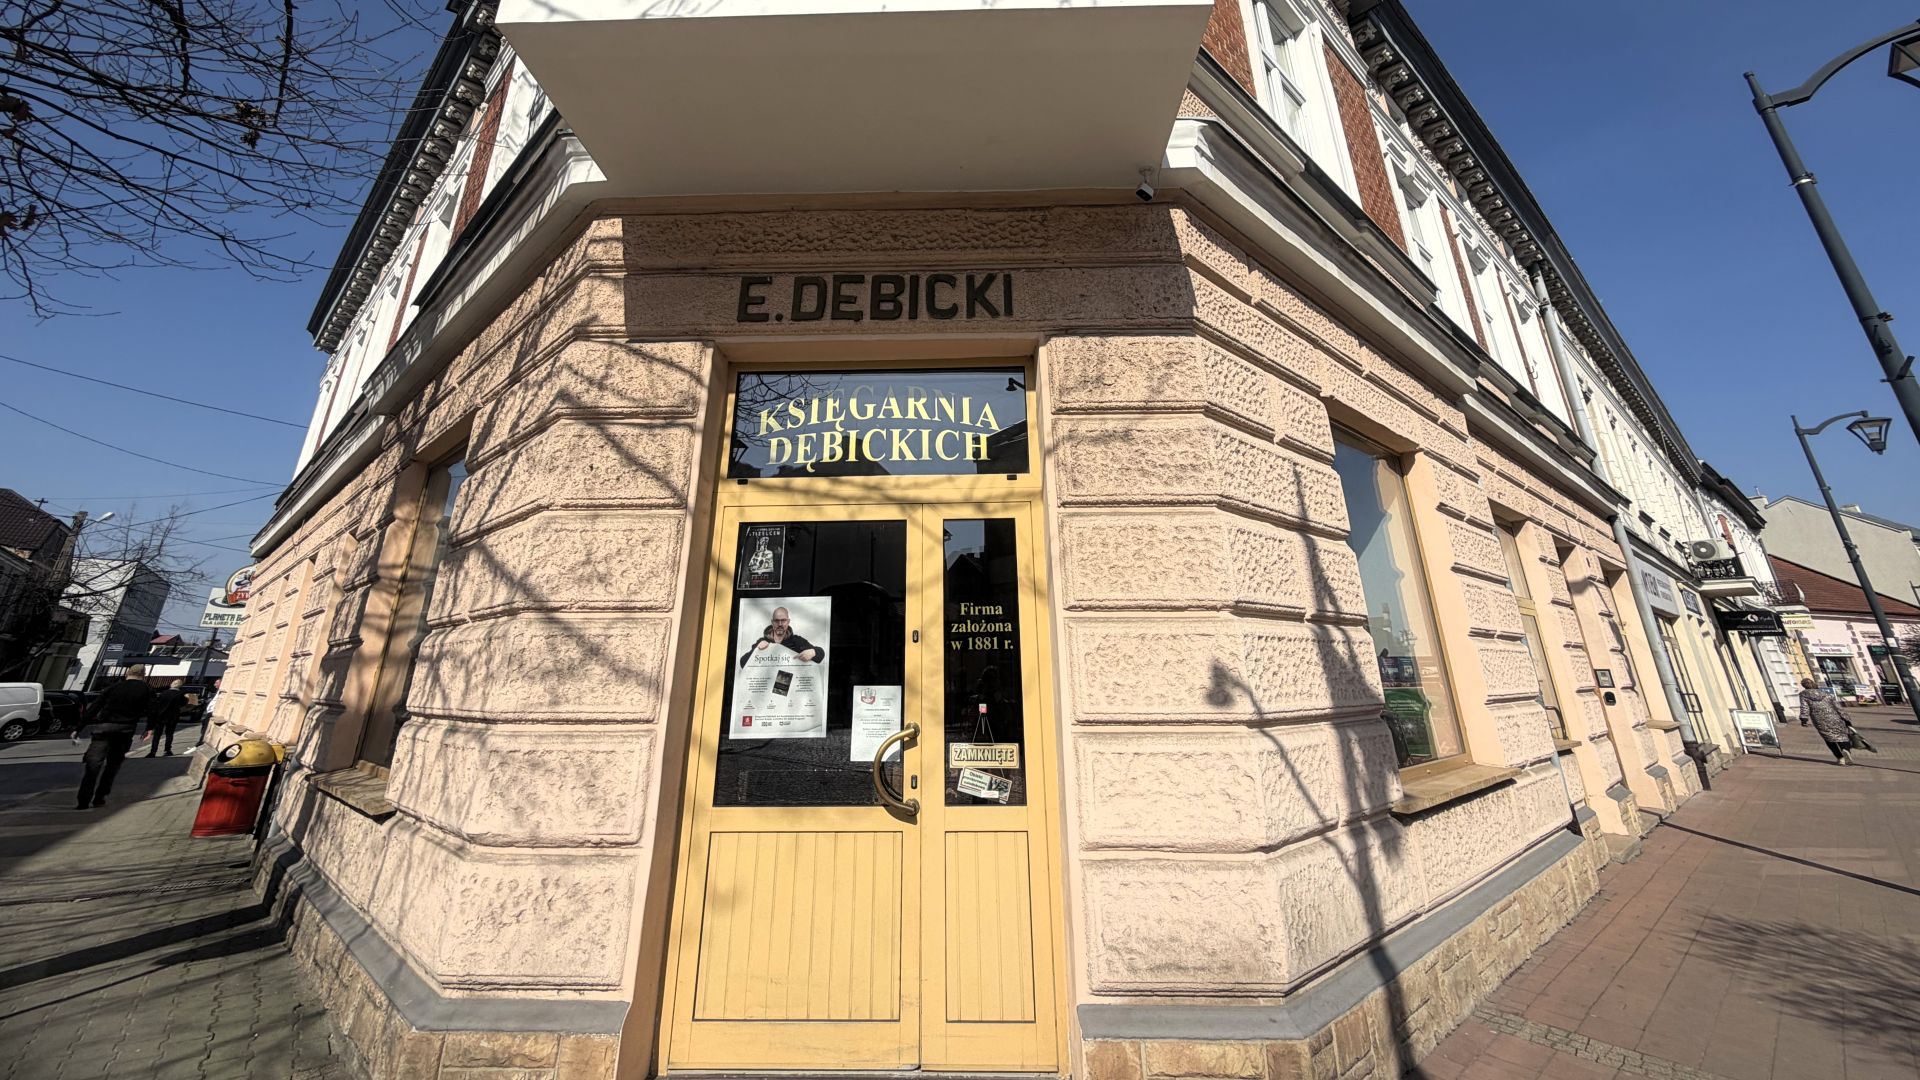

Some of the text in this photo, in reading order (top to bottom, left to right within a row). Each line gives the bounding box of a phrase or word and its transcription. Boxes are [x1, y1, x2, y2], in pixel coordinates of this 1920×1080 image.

[757, 384, 1000, 437] KSIĘGARNIA
[766, 428, 992, 472] DĘBICKICH
[960, 602, 1003, 616] Firma
[204, 613, 235, 621] PLANETA
[951, 619, 1013, 633] założona
[951, 636, 1014, 651] w 1881 r.
[754, 654, 791, 664] Spotkaj się
[954, 747, 1015, 765] ZAMKNIĘTE
